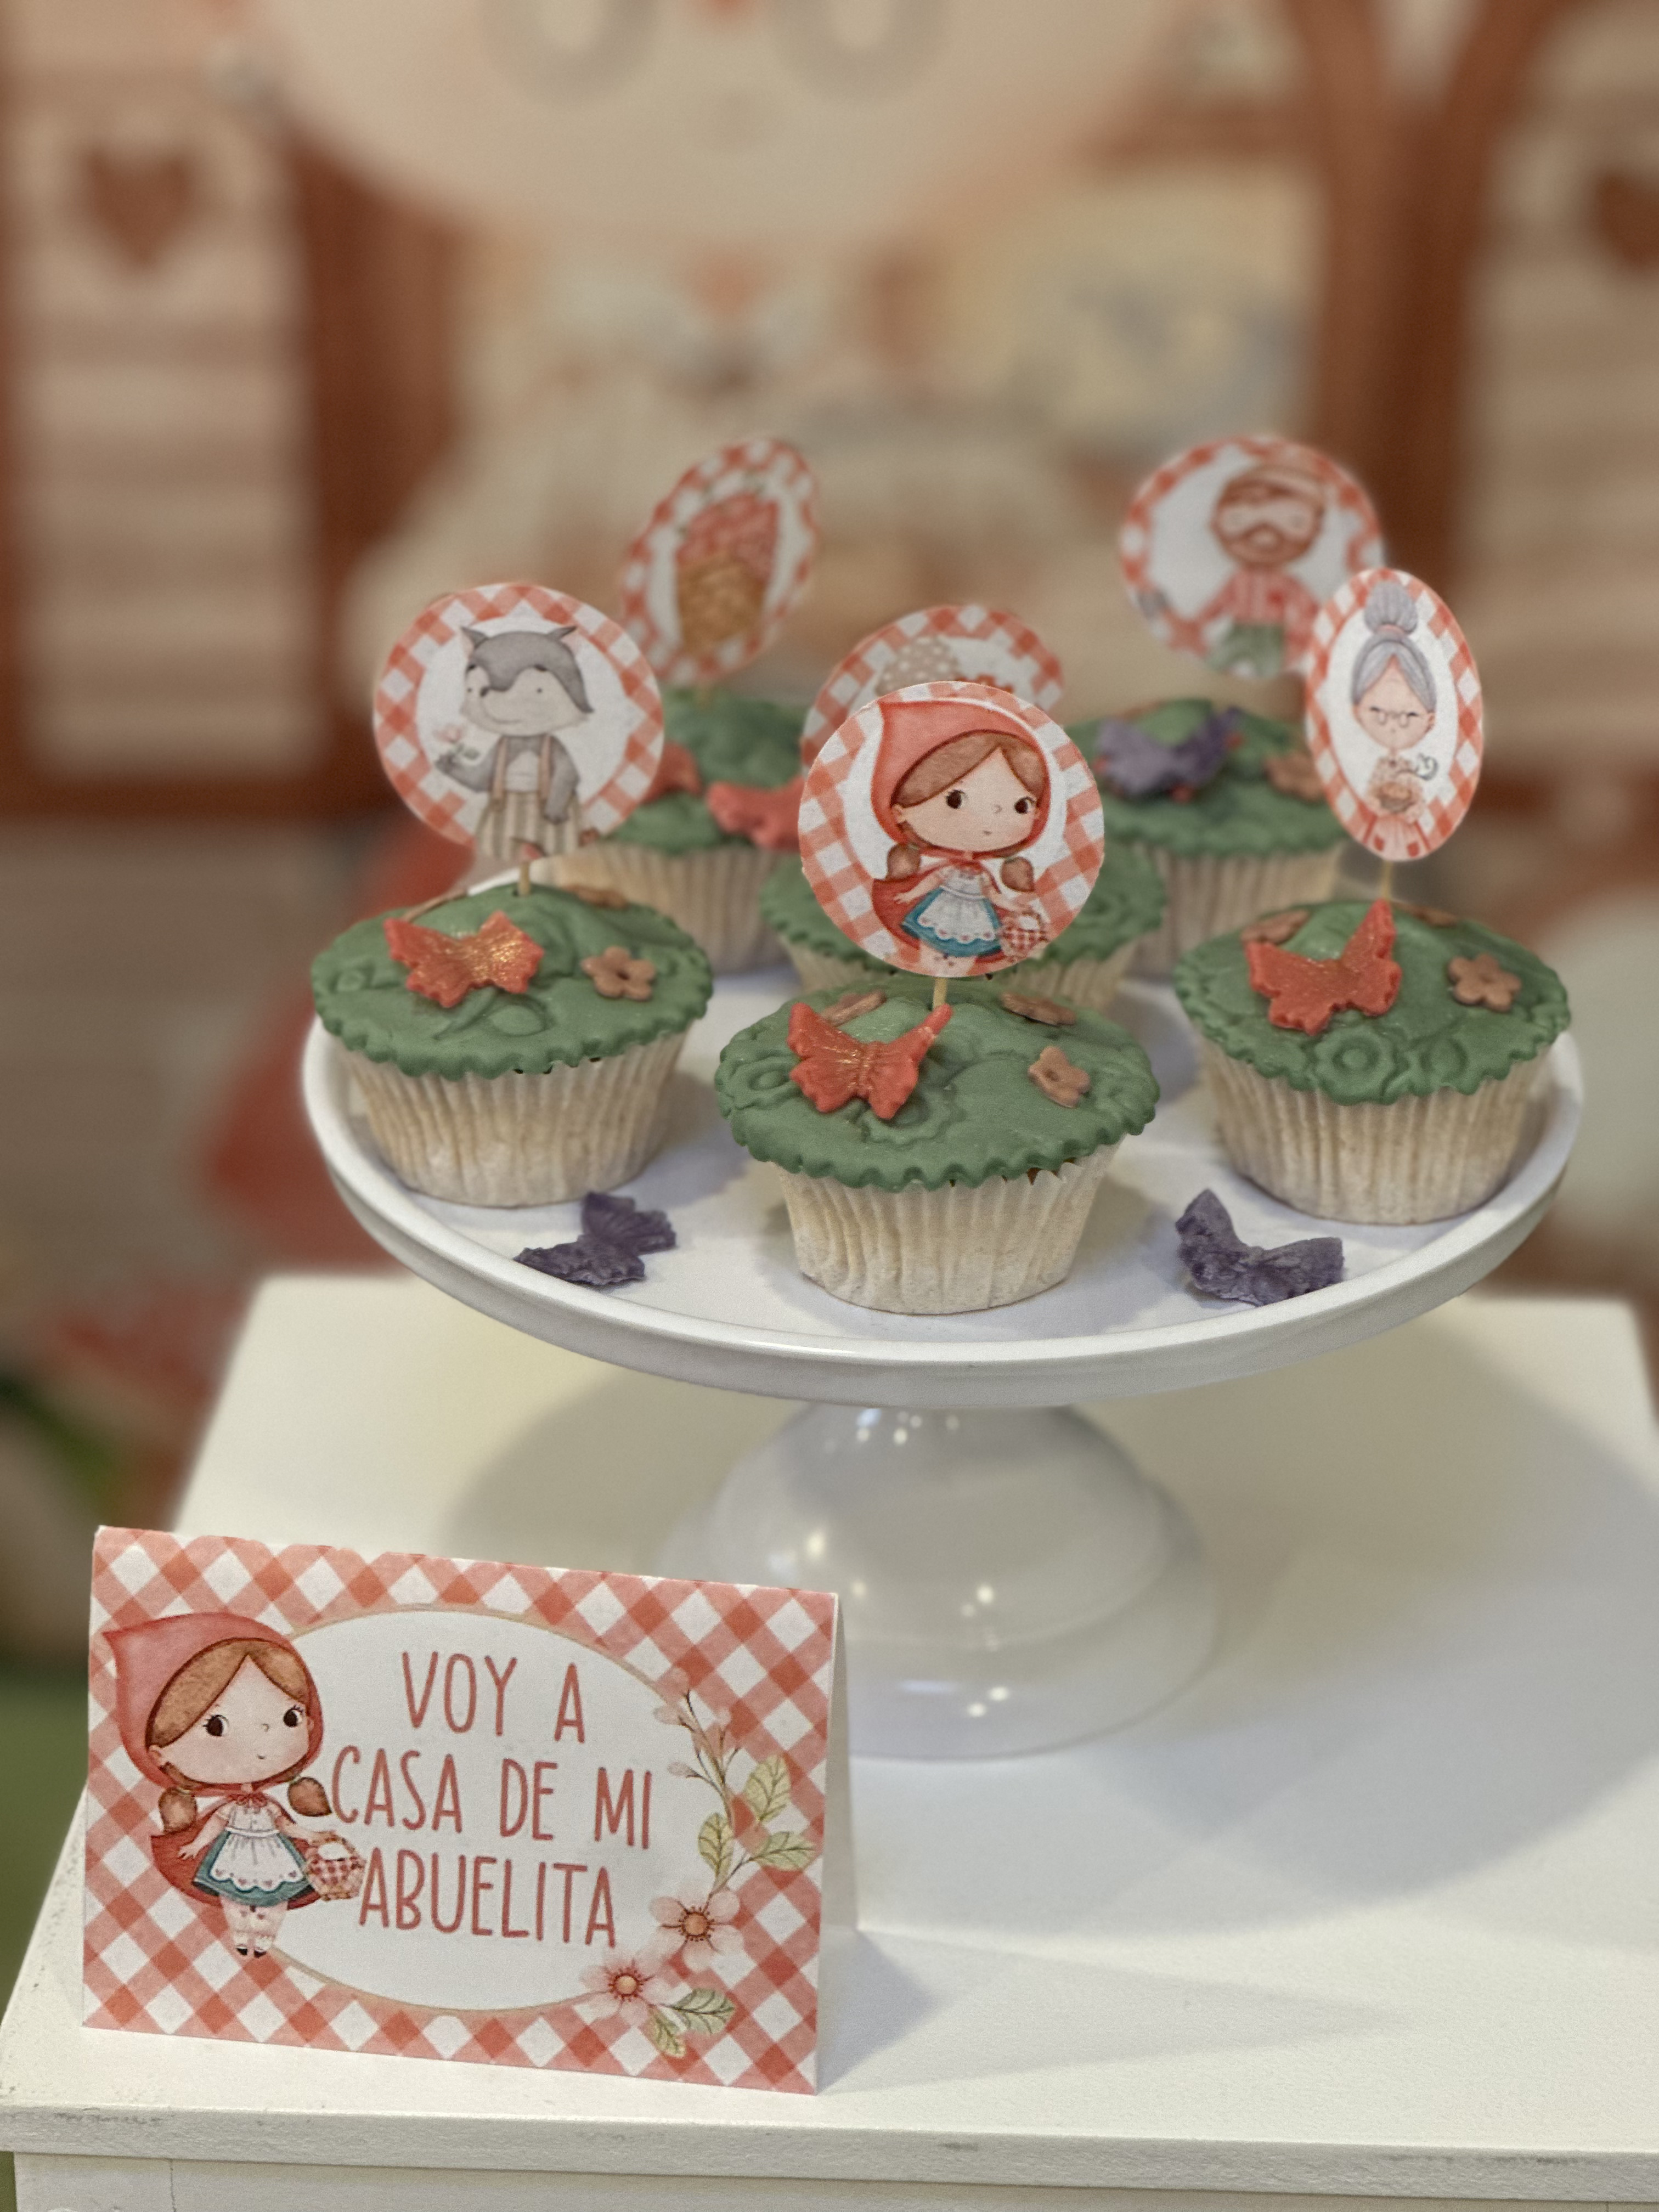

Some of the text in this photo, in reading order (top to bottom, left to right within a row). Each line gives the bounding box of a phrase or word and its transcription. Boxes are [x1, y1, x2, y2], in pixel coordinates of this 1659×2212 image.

[402, 1651, 585, 1743] VOY A
[331, 1745, 653, 1850] CASA DE MI
[359, 1847, 617, 1949] ABUELITA
